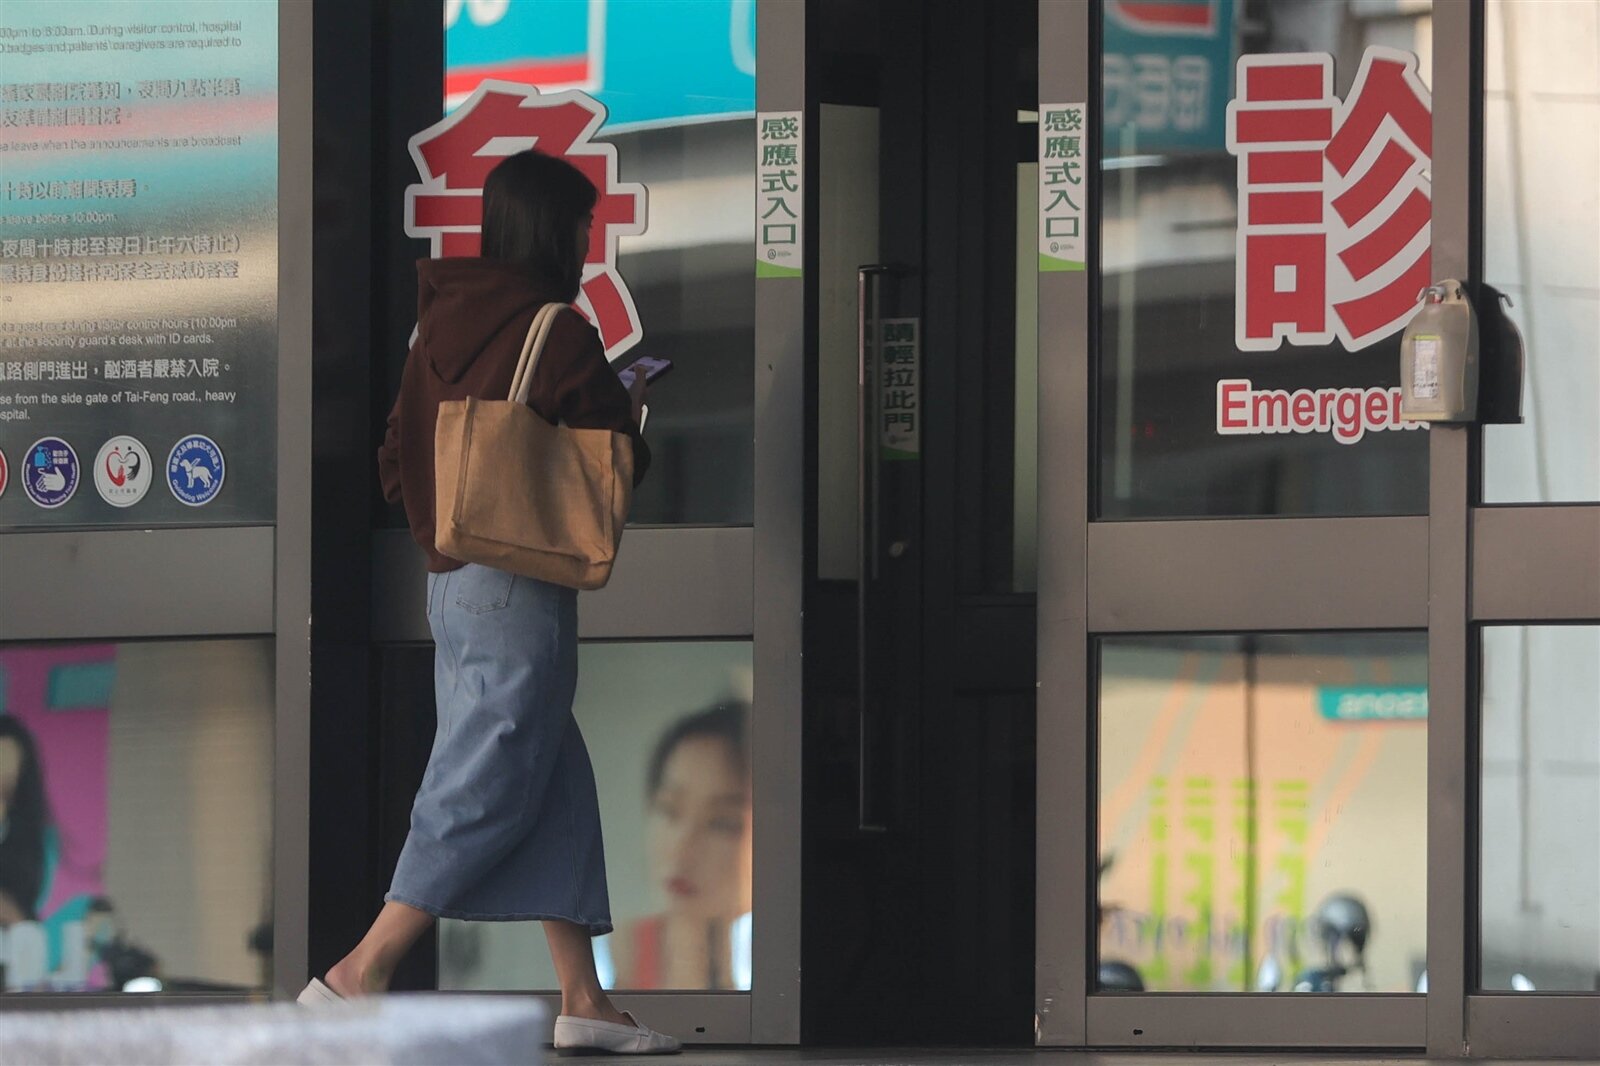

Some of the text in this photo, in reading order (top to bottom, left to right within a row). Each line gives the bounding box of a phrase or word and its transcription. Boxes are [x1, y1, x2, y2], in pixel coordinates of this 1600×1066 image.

[761, 116, 799, 245] 感應式入口
[1043, 108, 1082, 238] 感應式入口
[1230, 50, 1432, 347] 診
[119, 334, 143, 344] desk
[145, 333, 167, 344] with
[169, 333, 180, 344] ID
[183, 332, 215, 343] cards.
[162, 318, 189, 329] hours
[15, 393, 39, 404] from
[41, 393, 58, 404] the
[61, 392, 82, 404] side
[85, 392, 108, 406] gate
[111, 391, 122, 403] of
[124, 391, 169, 404] Tai-Feng
[205, 390, 237, 403] heavy
